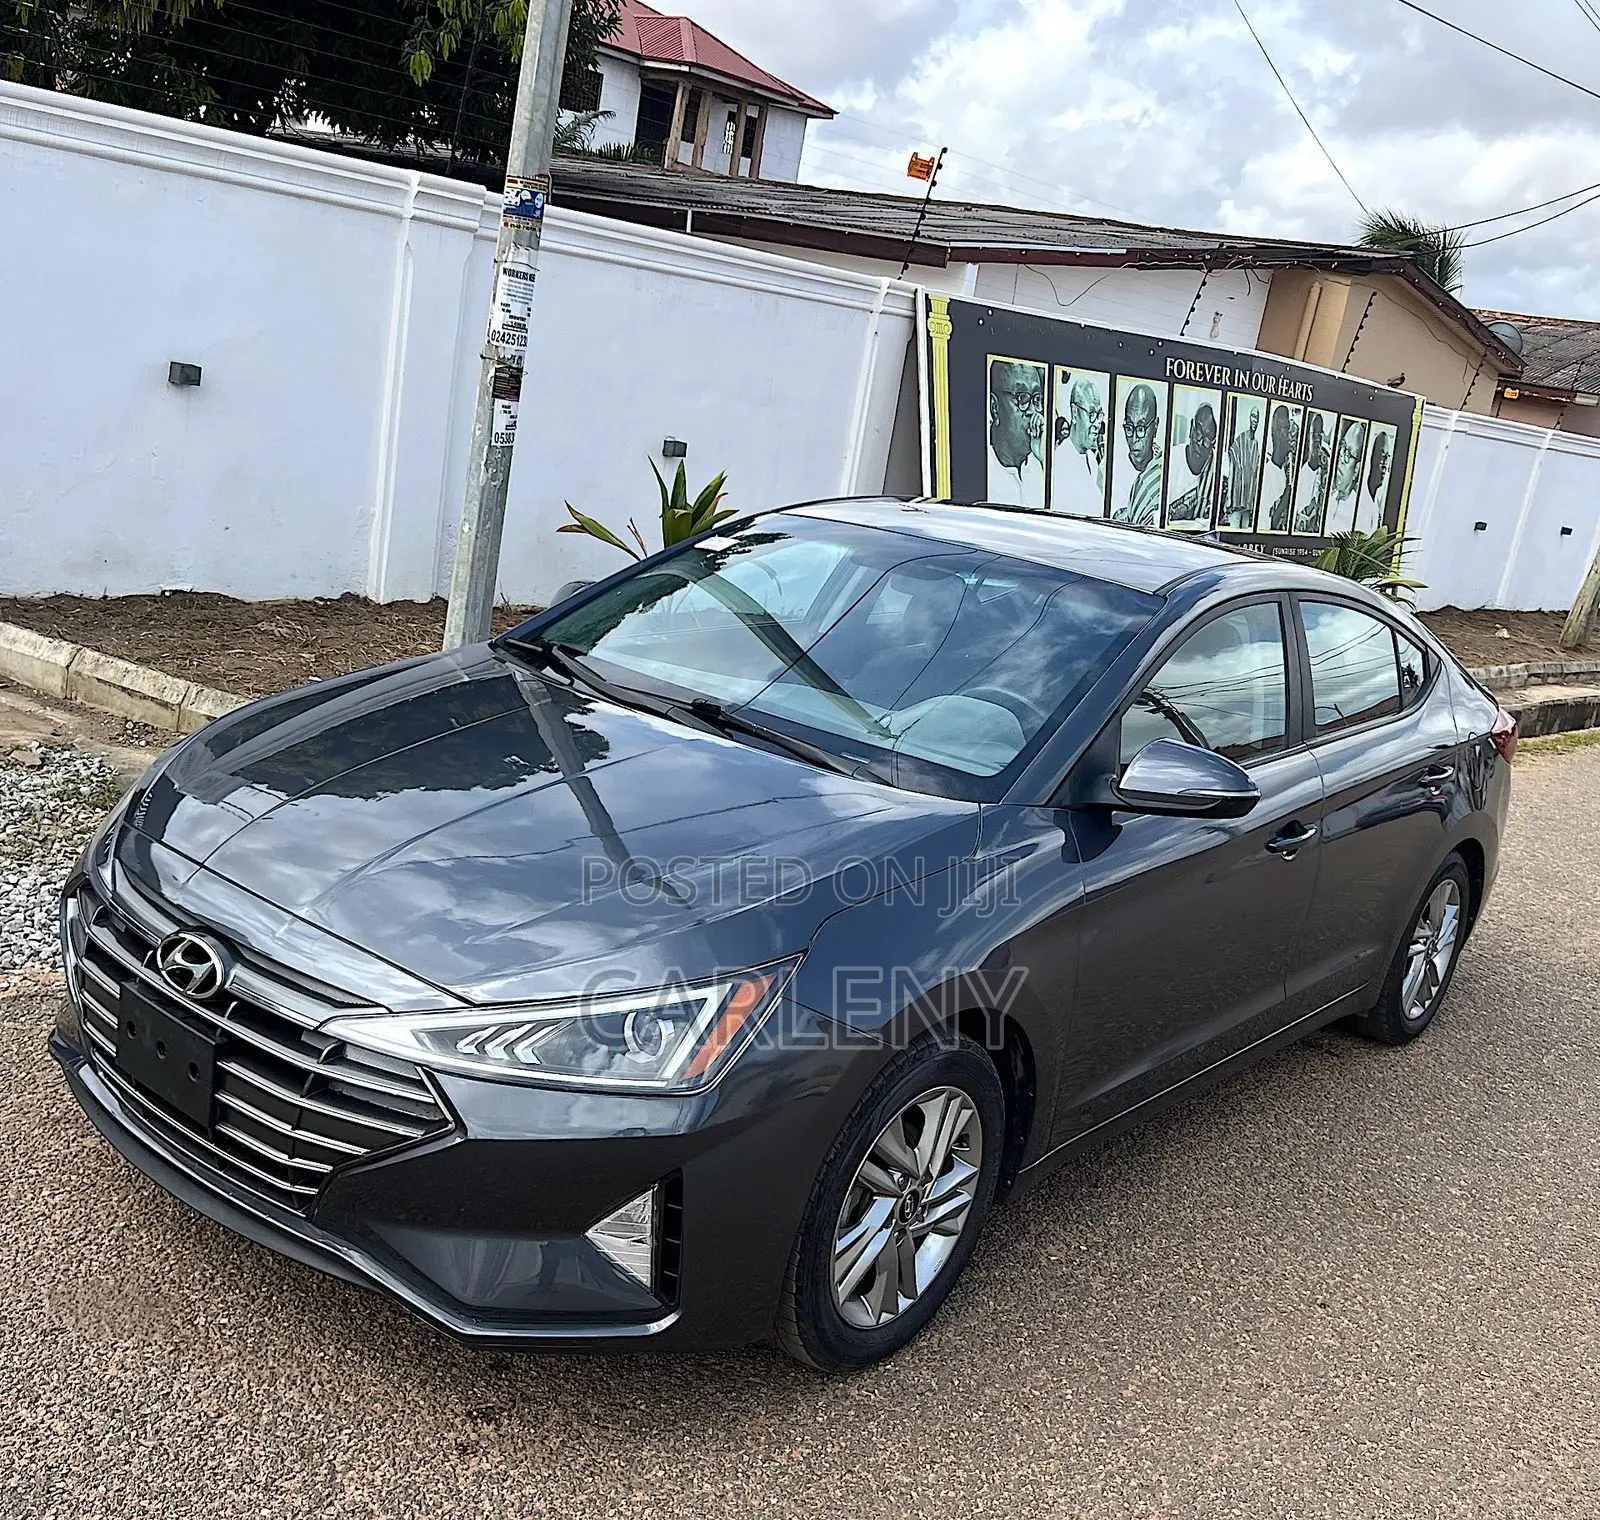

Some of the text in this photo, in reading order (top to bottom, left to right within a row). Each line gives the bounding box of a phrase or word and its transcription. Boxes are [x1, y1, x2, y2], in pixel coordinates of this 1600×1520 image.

[1165, 357, 1314, 402] FOREVER IN OUR HEARTS
